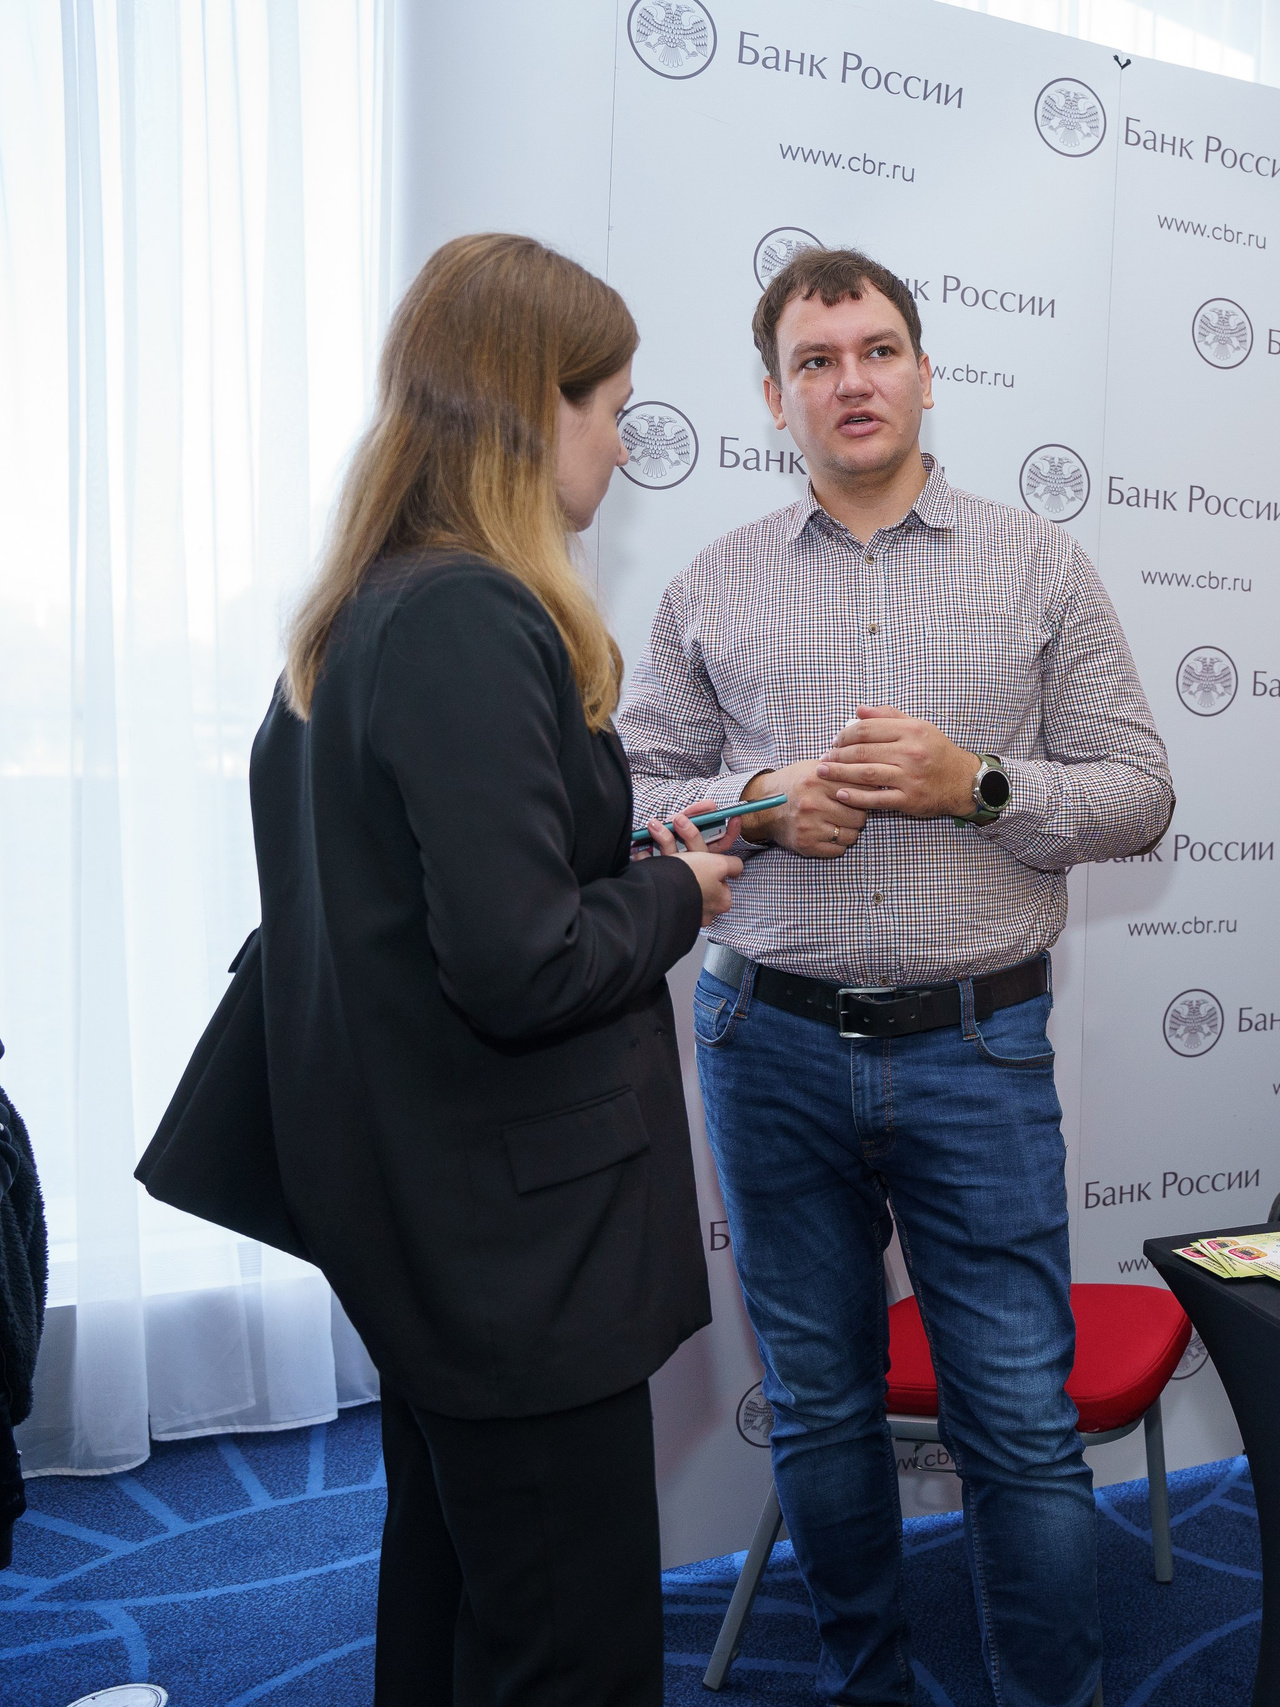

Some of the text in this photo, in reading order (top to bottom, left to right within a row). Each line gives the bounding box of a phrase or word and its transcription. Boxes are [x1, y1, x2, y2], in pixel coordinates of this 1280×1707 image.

[737, 30, 964, 109] Банк России
[1124, 116, 1194, 160] Банк
[779, 143, 915, 183] www.cbr.ru
[1157, 214, 1267, 250] www.cbr.ru
[942, 274, 1057, 319] России
[932, 363, 1016, 390] w.cbr.ru
[719, 435, 807, 476] Банк
[1107, 475, 1178, 512] Банк
[1140, 570, 1252, 594] www.cbr.ru
[1173, 834, 1275, 863] России
[1127, 915, 1238, 938] www.cbr.ru
[1084, 1168, 1260, 1210] Банк России
